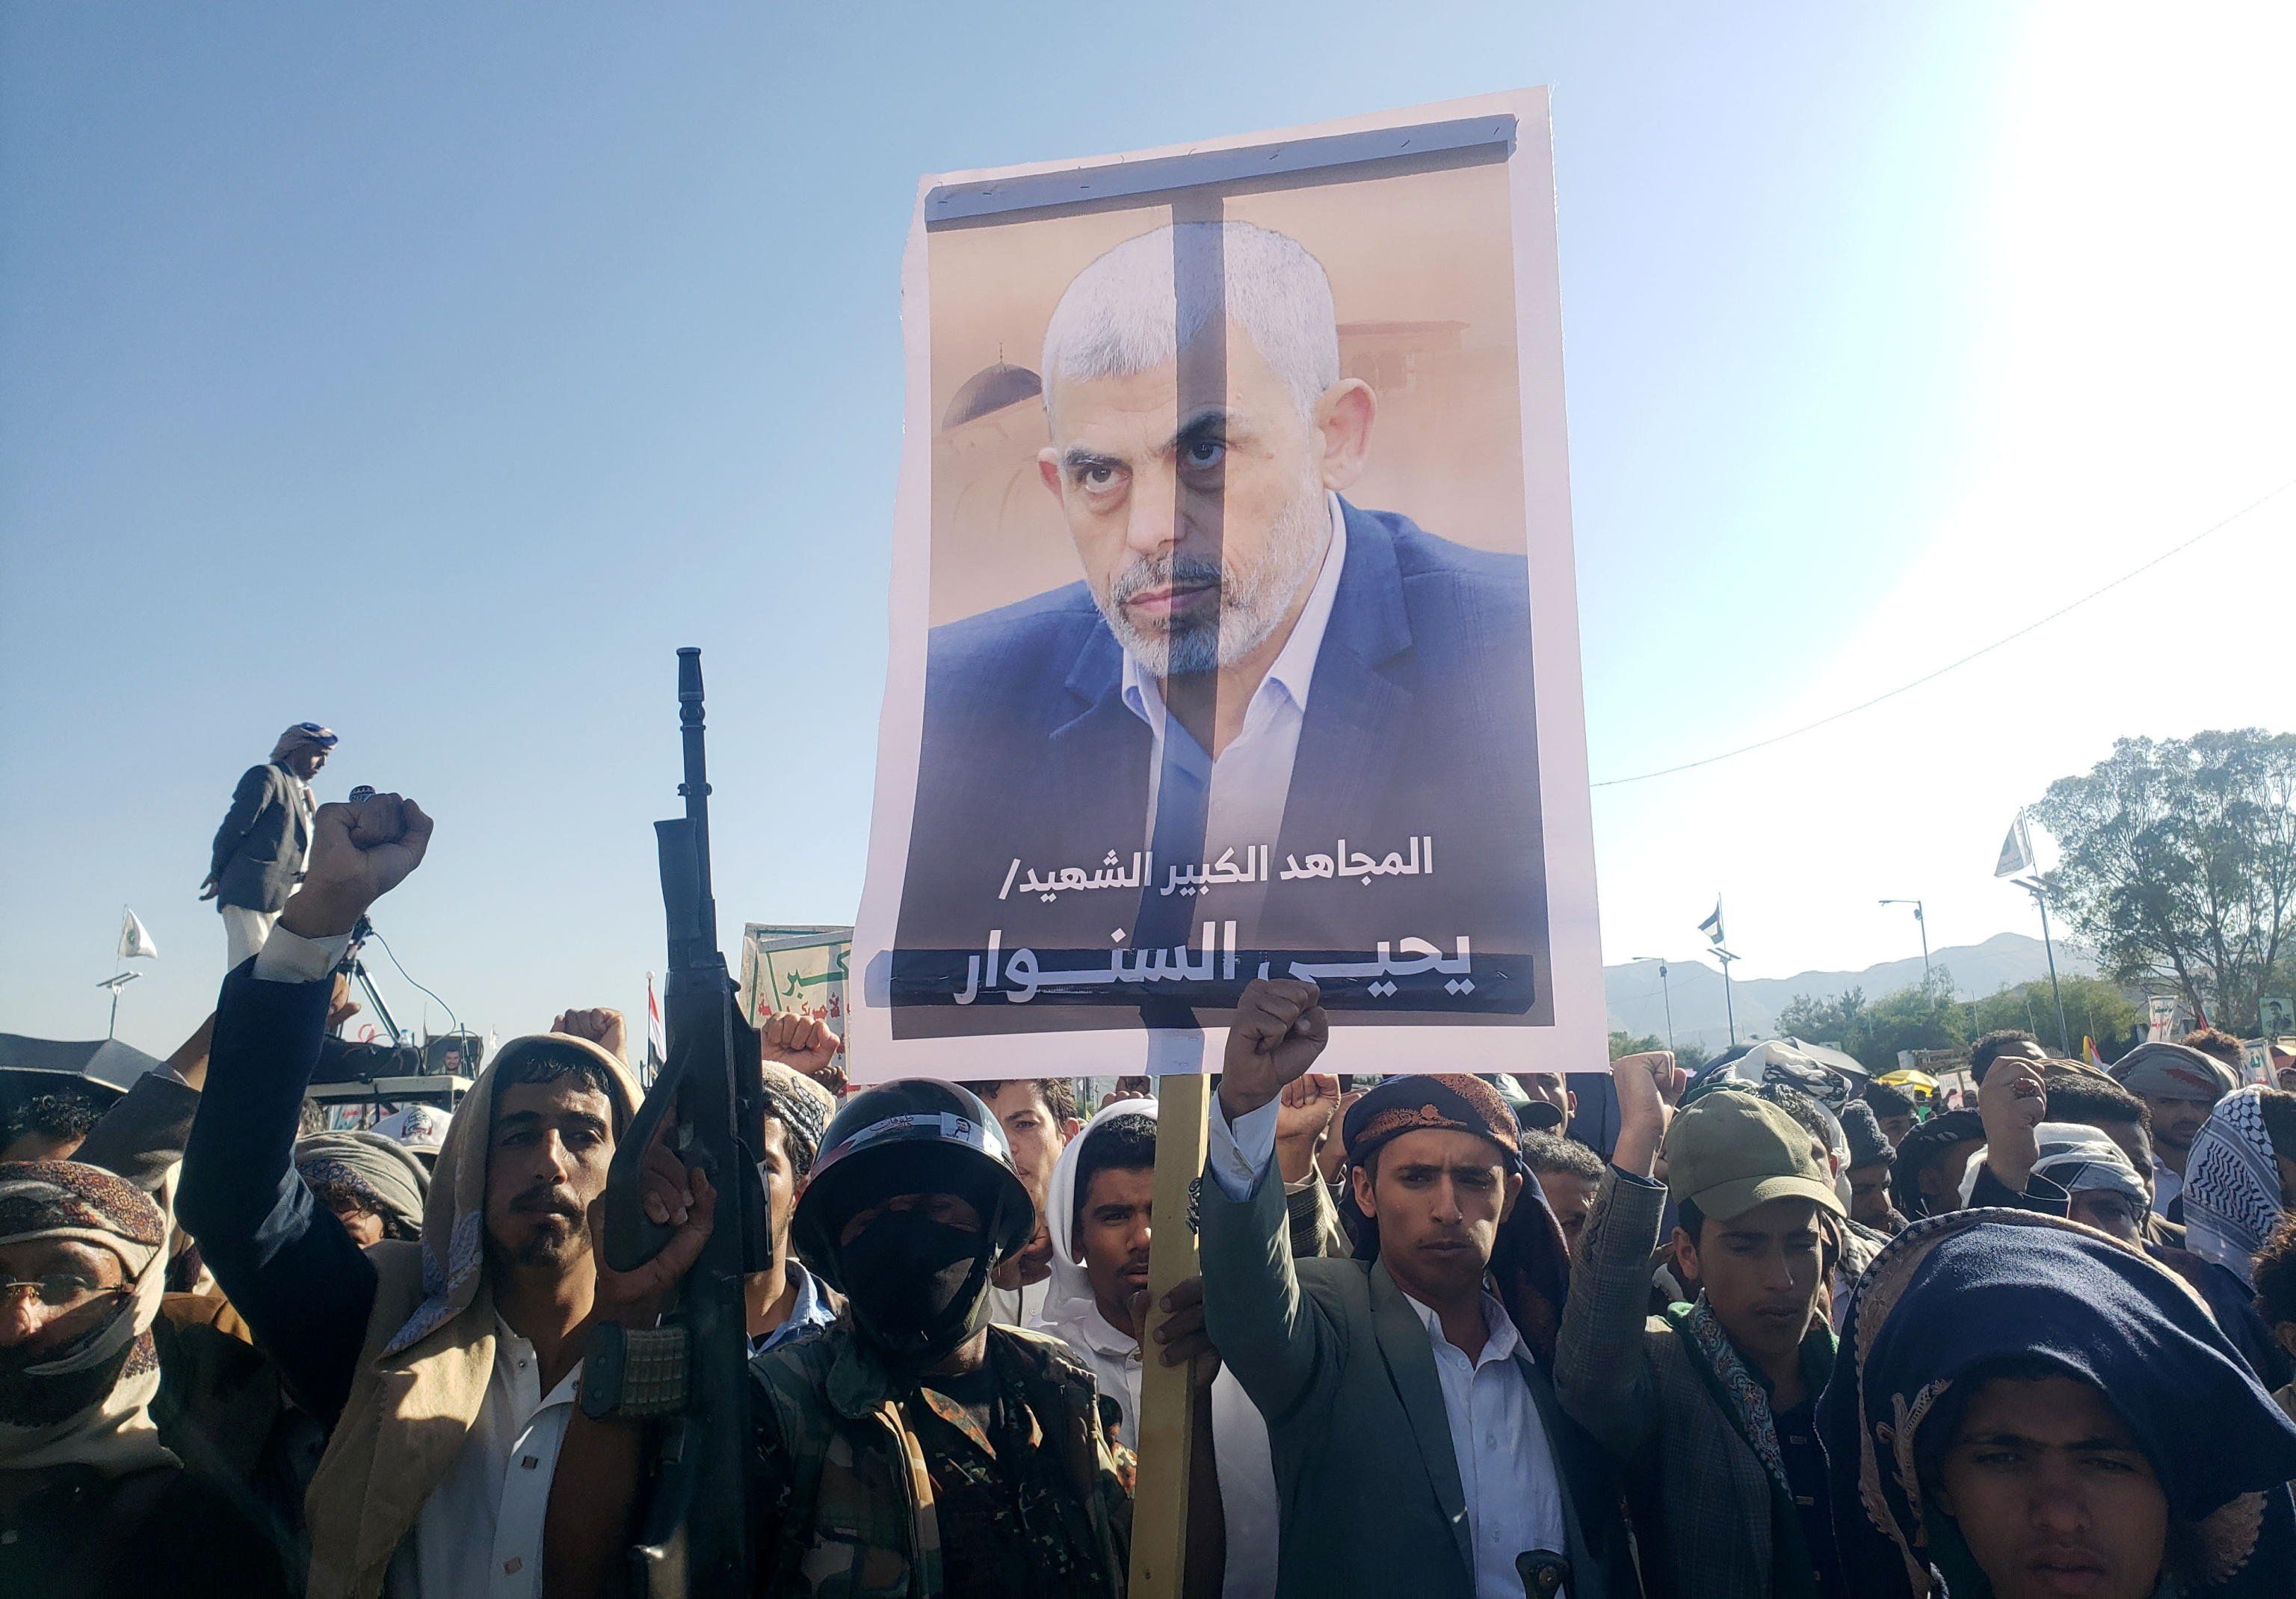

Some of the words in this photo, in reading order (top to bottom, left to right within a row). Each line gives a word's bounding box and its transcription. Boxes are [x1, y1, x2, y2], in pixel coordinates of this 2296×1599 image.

[1160, 844, 1268, 896] الكبير
[1280, 836, 1433, 887] المجاهد
[953, 920, 1237, 1005] السنوار
